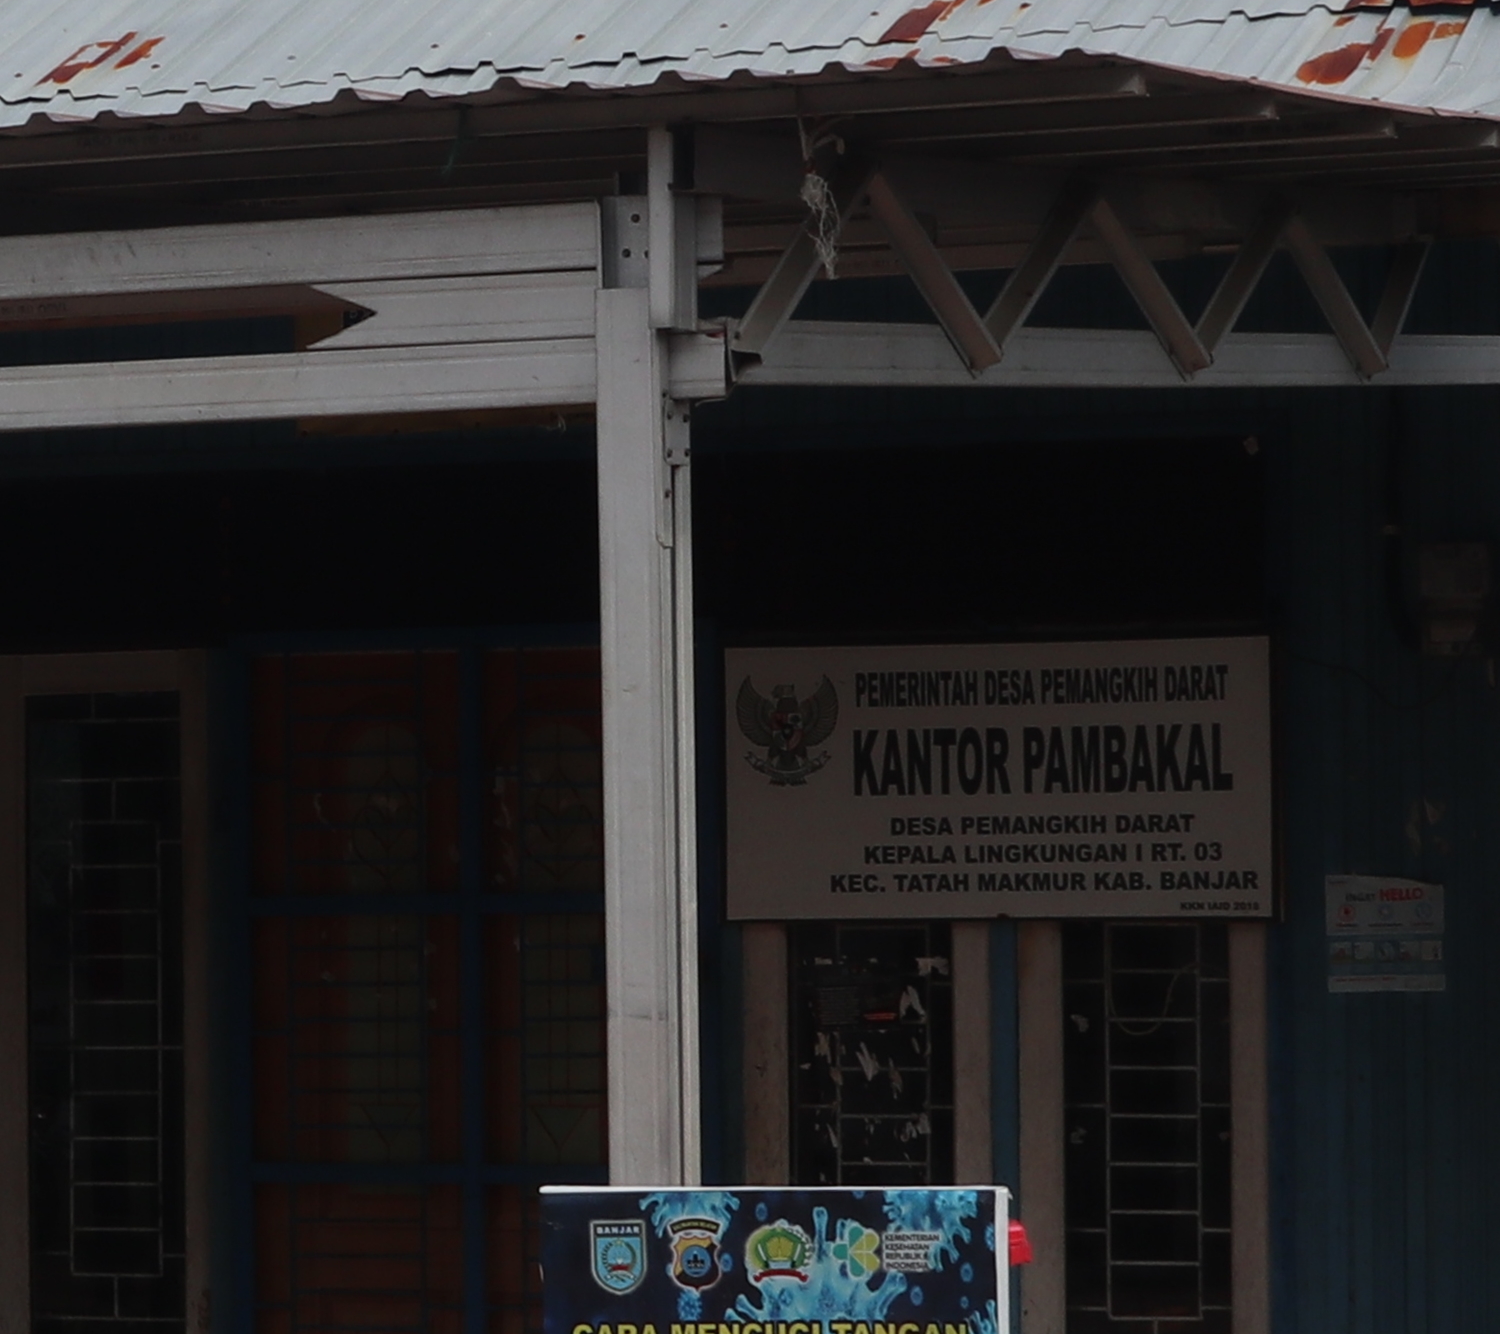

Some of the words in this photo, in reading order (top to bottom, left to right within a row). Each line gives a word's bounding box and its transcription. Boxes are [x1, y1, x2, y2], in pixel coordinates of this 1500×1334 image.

[855, 671, 977, 707] PEMERINTAH
[984, 670, 1035, 706] DESA
[1041, 667, 1158, 705] PEMANGKIH
[1165, 665, 1228, 702] DARAT
[852, 727, 1011, 796] KANTOR
[1022, 723, 1233, 794] PAMBAKAL
[890, 817, 953, 836] DESA
[960, 815, 1107, 835] PEMANGKIH
[1117, 814, 1196, 833] DARAT
[863, 844, 956, 864] KEPALA
[964, 843, 1127, 863] LINGKUNGAN
[1135, 843, 1142, 862] I
[1151, 842, 1186, 862] RT.
[1194, 841, 1222, 862] 03
[830, 874, 886, 893] KEC.
[893, 873, 969, 892] TATAH
[978, 872, 1087, 892] MAKMUR
[1094, 872, 1152, 891] KAB.
[1160, 870, 1258, 890] BANJAR
[1379, 887, 1424, 902] HELLO
[1180, 902, 1205, 910] KKN
[596, 1226, 640, 1235] BANJAR
[885, 1234, 940, 1242] KEMENTERIAN
[885, 1243, 930, 1251] KESEHATAN
